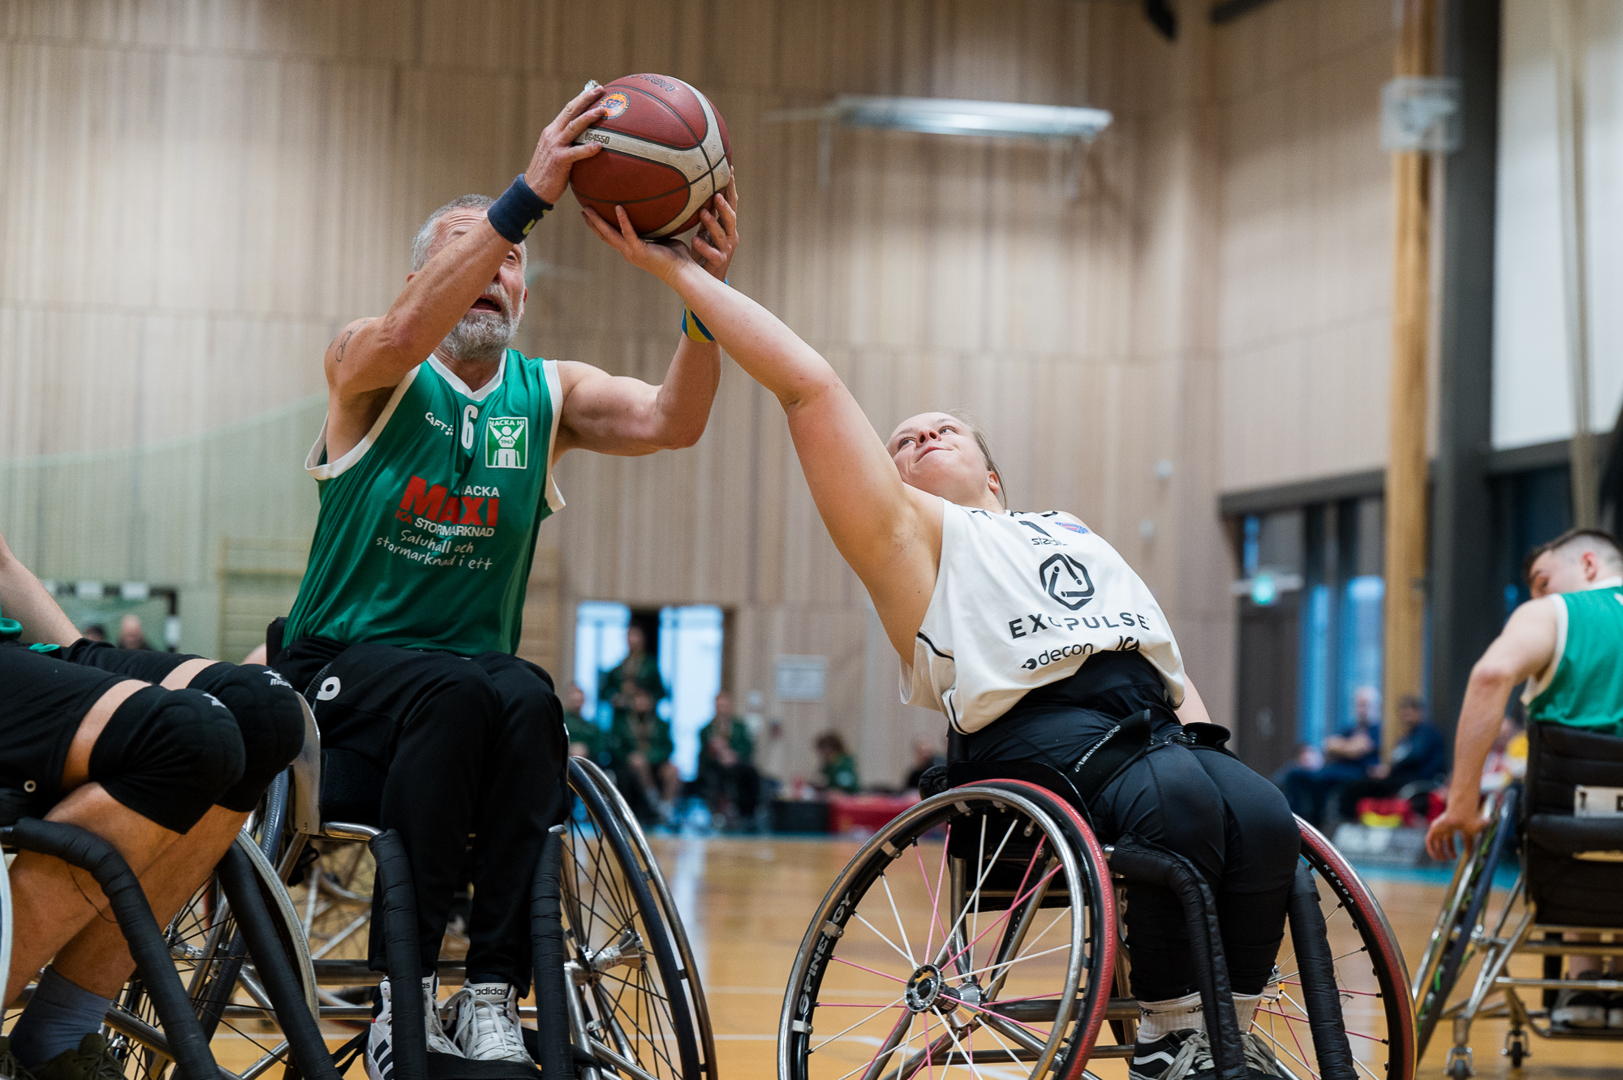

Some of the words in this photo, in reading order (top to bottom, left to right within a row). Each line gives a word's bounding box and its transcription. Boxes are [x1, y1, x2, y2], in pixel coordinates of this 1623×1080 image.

[461, 405, 478, 450] 6
[399, 475, 500, 526] MAXI
[394, 509, 413, 525] ICA
[414, 517, 495, 537] STORMARKNAD
[376, 536, 456, 567] stormarknad
[458, 555, 466, 567] i
[467, 556, 493, 571] ett
[400, 529, 452, 554] Saluhall
[453, 541, 474, 553] och
[1038, 643, 1093, 666] decon
[799, 891, 851, 1016] SPINEGY
[475, 987, 507, 996] adidas
